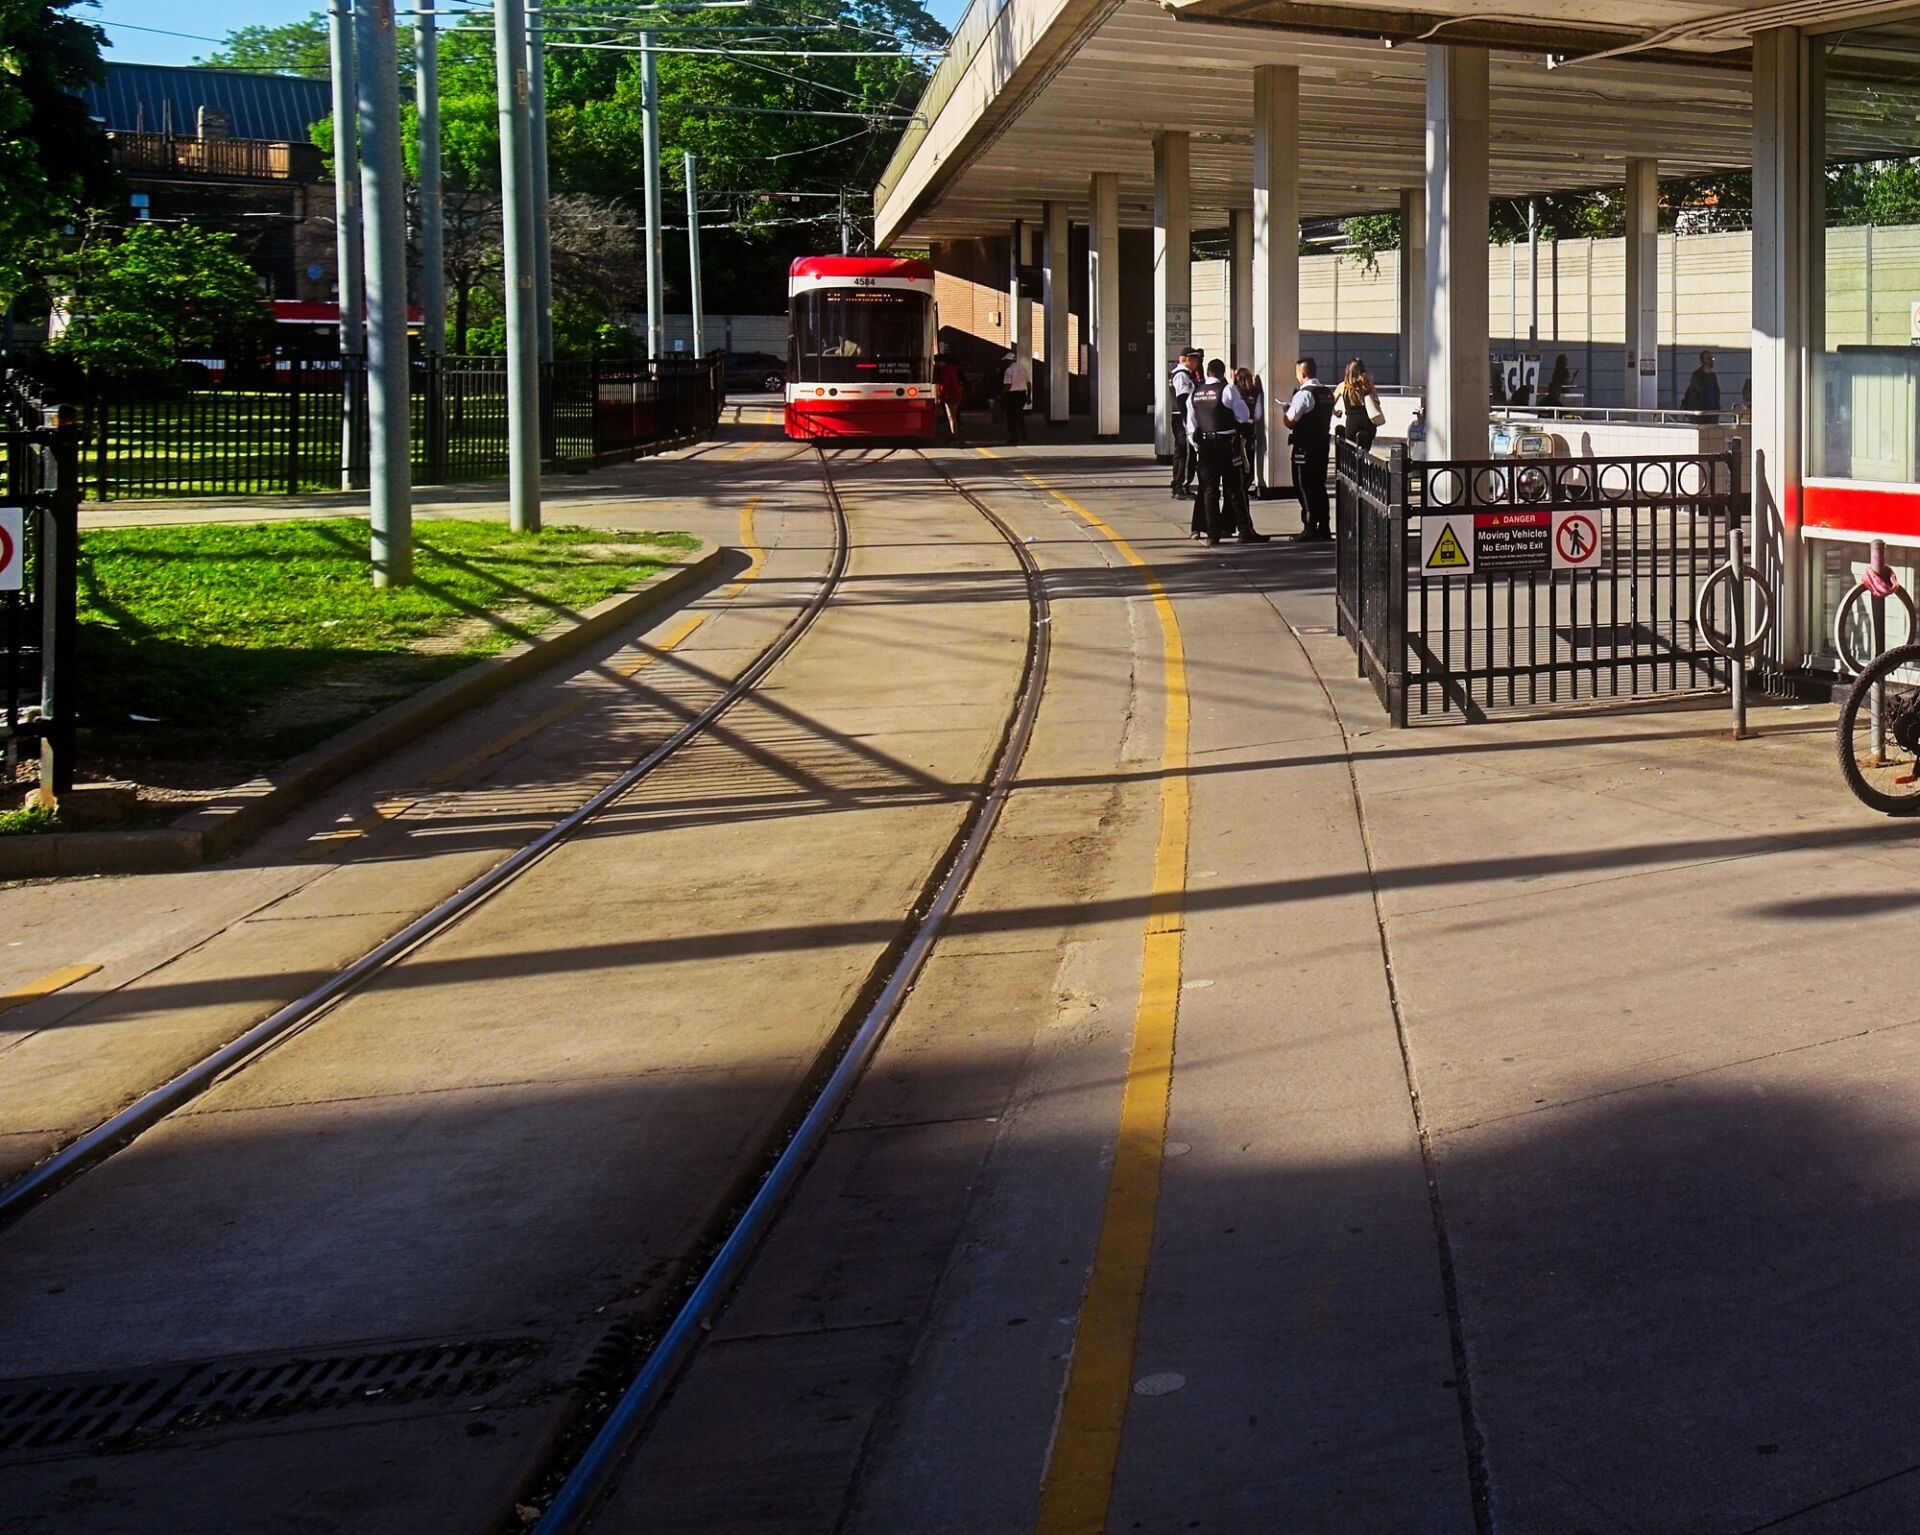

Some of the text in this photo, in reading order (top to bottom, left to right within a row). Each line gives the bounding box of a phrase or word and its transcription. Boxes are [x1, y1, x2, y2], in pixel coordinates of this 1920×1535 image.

[854, 278, 875, 286] 4584
[1503, 515, 1536, 524] DANGER
[1478, 529, 1548, 541] Moving Vehicles
[1495, 543, 1528, 552] Entry/No
[1529, 542, 1543, 550] Exit
